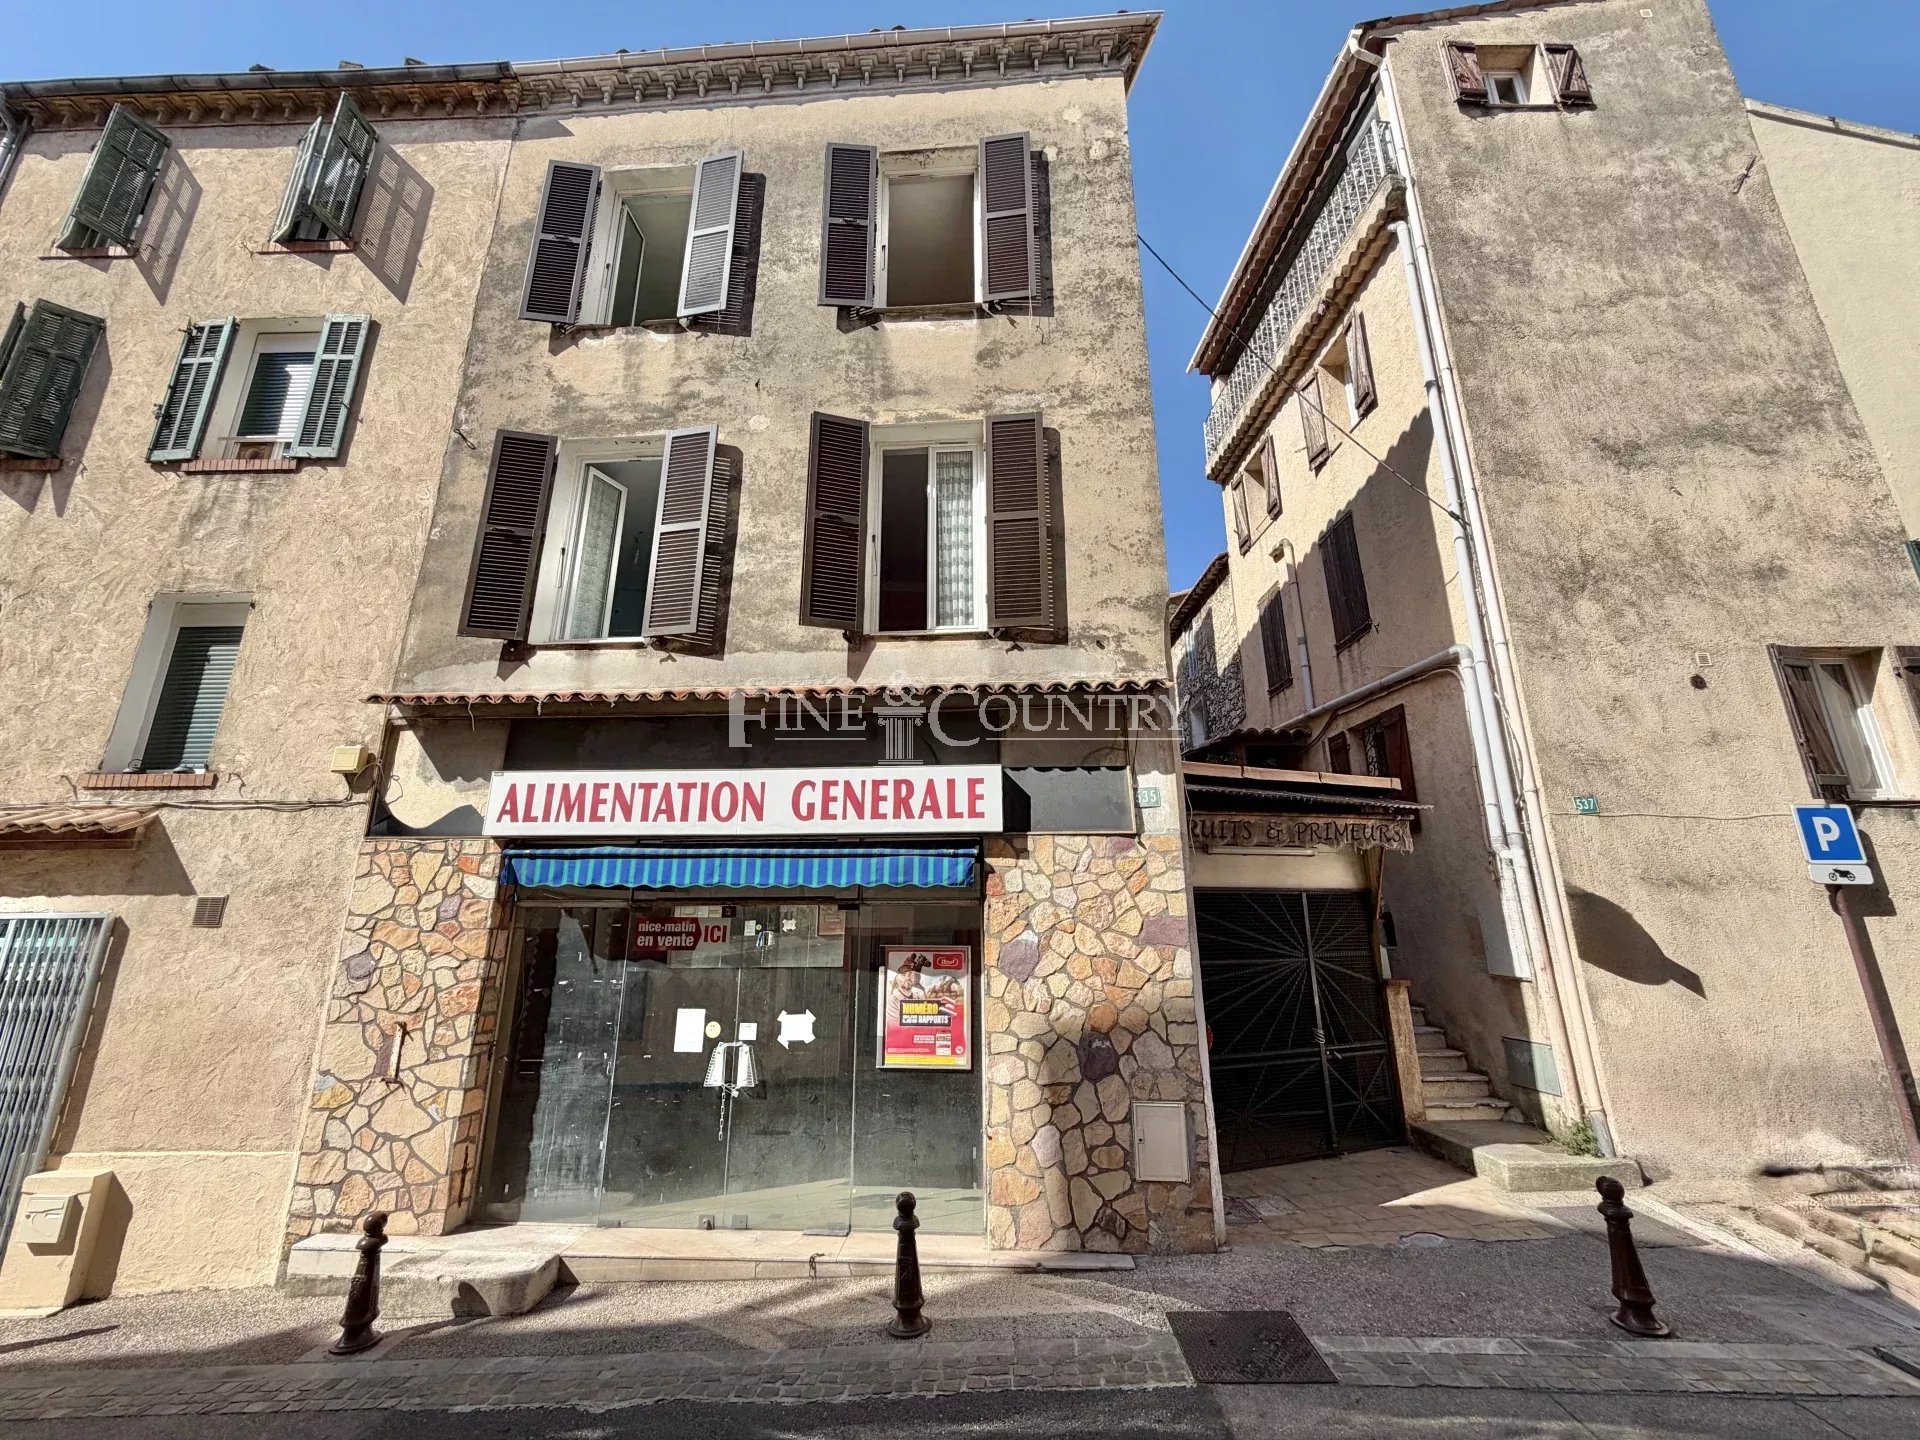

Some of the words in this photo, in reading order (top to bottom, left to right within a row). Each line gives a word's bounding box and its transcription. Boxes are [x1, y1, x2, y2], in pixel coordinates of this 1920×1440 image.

[496, 781, 767, 823] ALIMENTATION
[791, 777, 985, 821] GENERALE
[1576, 798, 1594, 810] 537
[1266, 821, 1283, 840] &
[1295, 821, 1401, 843] PRIMEURS
[1812, 816, 1840, 852] P
[637, 935, 654, 947] en
[657, 934, 695, 947] vente
[703, 925, 728, 943] ICI
[918, 1015, 949, 1024] RAPPORTS
